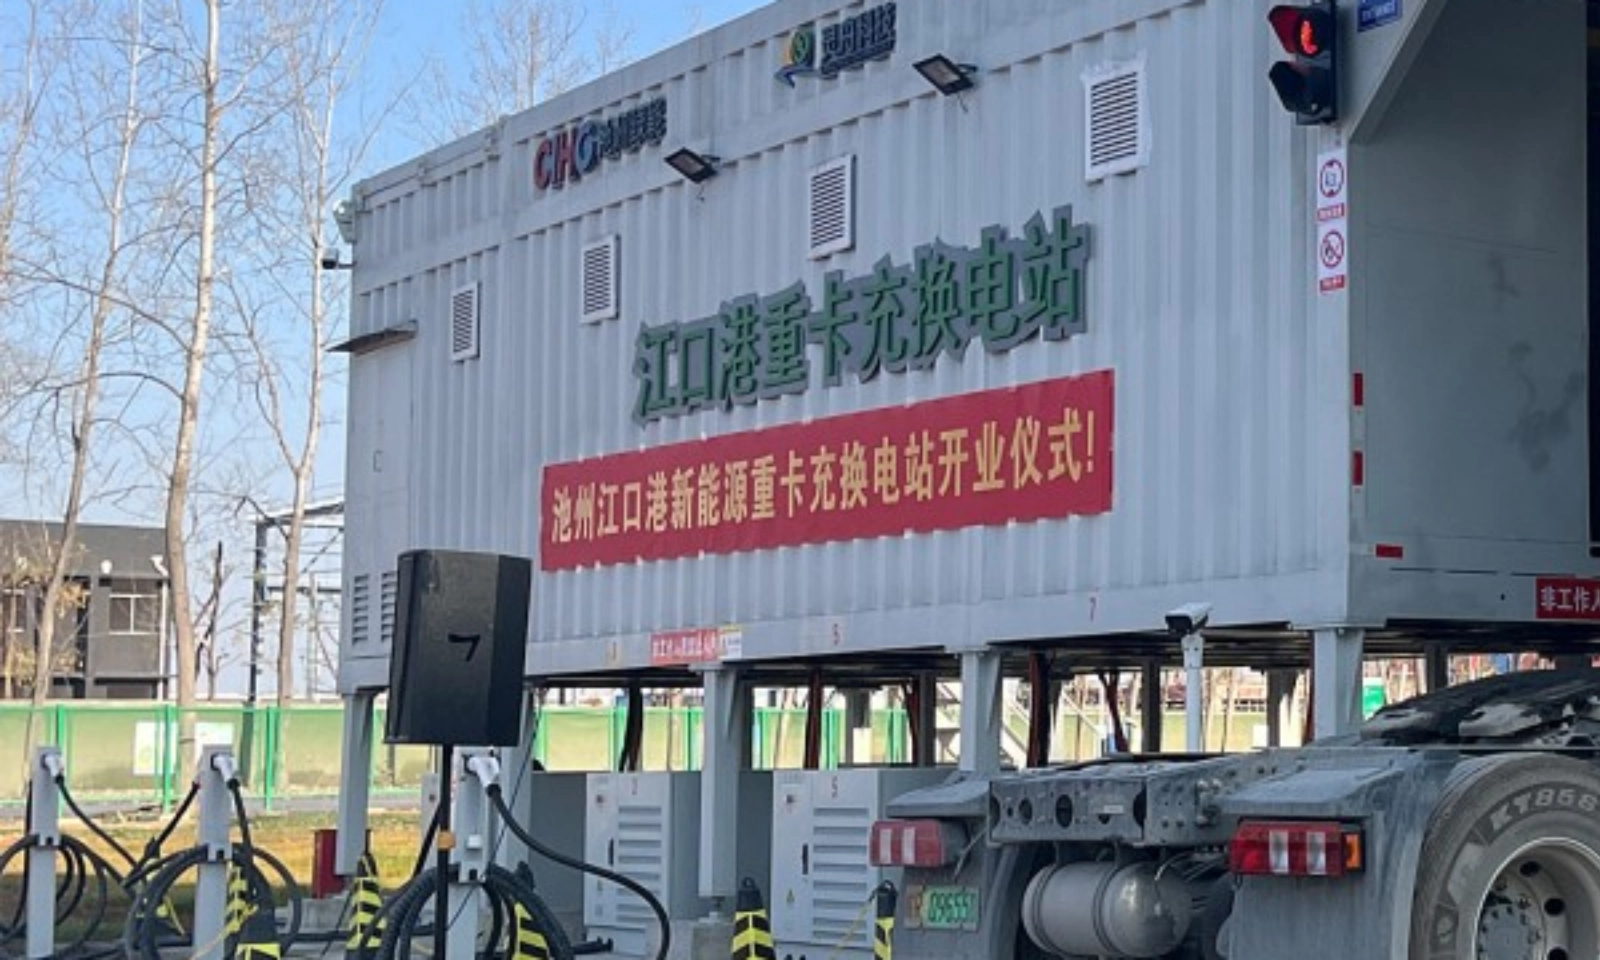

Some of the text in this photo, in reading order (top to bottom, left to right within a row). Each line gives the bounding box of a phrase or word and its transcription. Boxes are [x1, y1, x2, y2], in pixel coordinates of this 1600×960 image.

[633, 212, 1086, 418] 江口港重卡充换电站
[551, 406, 1095, 544] 池州江口港新能源重卡充换电站开业仪式!
